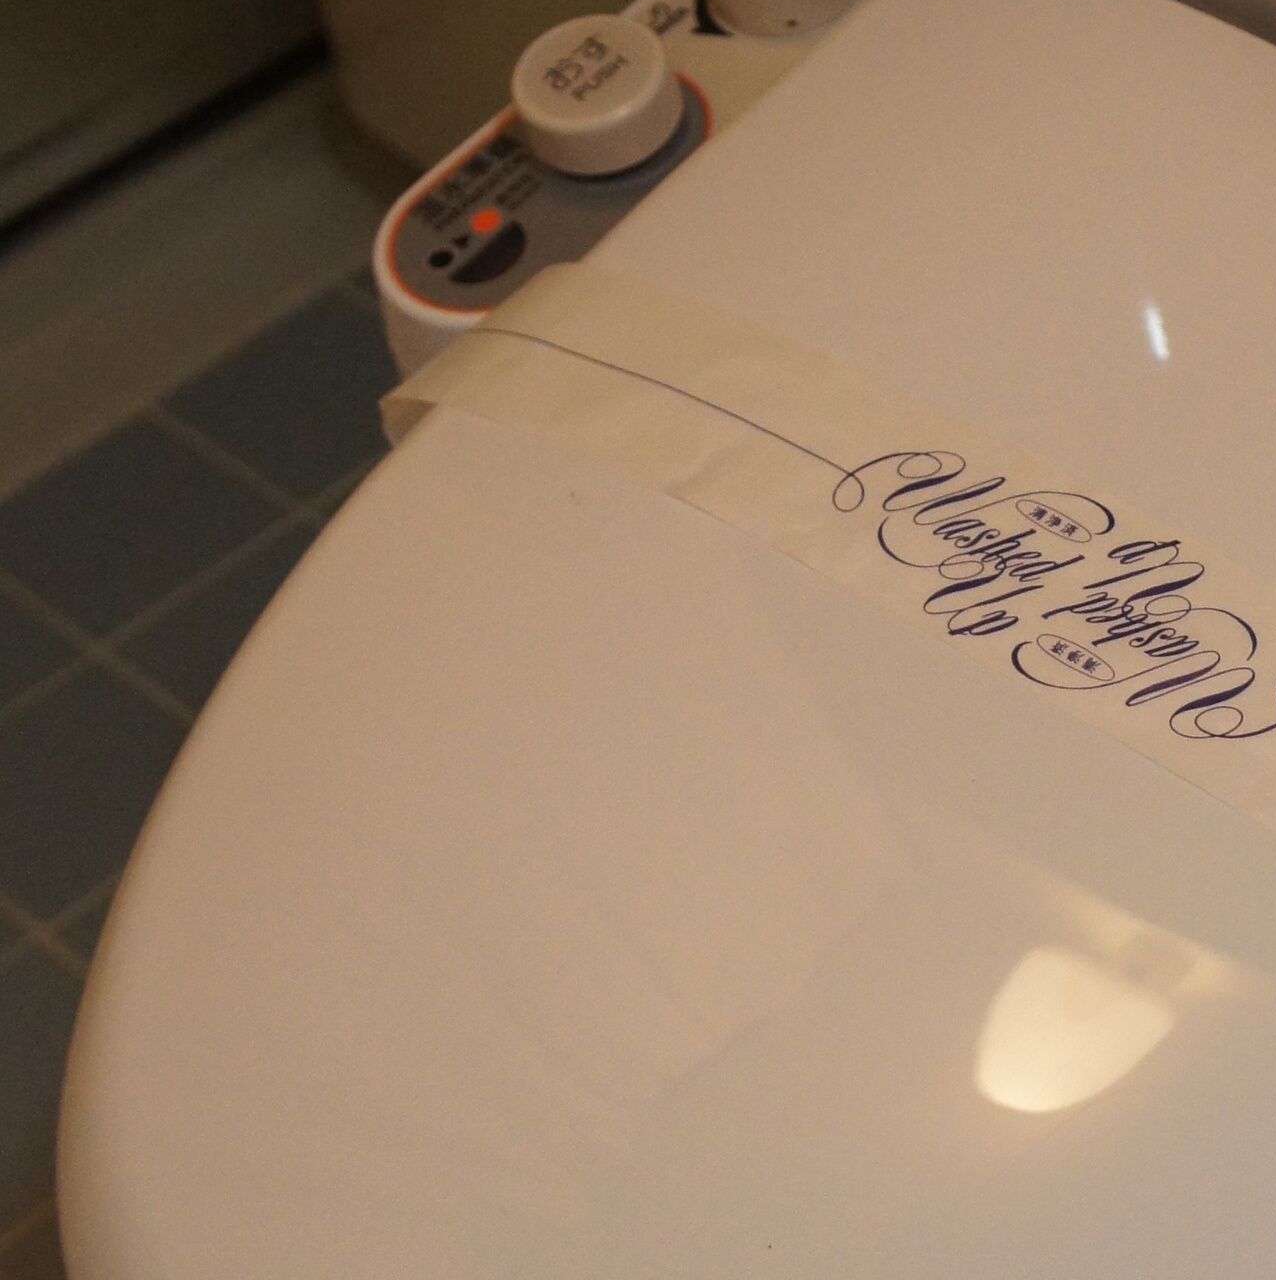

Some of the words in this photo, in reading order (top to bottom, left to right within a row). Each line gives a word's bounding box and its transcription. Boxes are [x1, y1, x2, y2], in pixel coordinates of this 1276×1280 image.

[571, 55, 629, 102] PUSH
[879, 450, 1084, 582] Washed
[922, 556, 1044, 636] Up
[1083, 539, 1206, 623] Up
[1042, 591, 1256, 739] Washed
